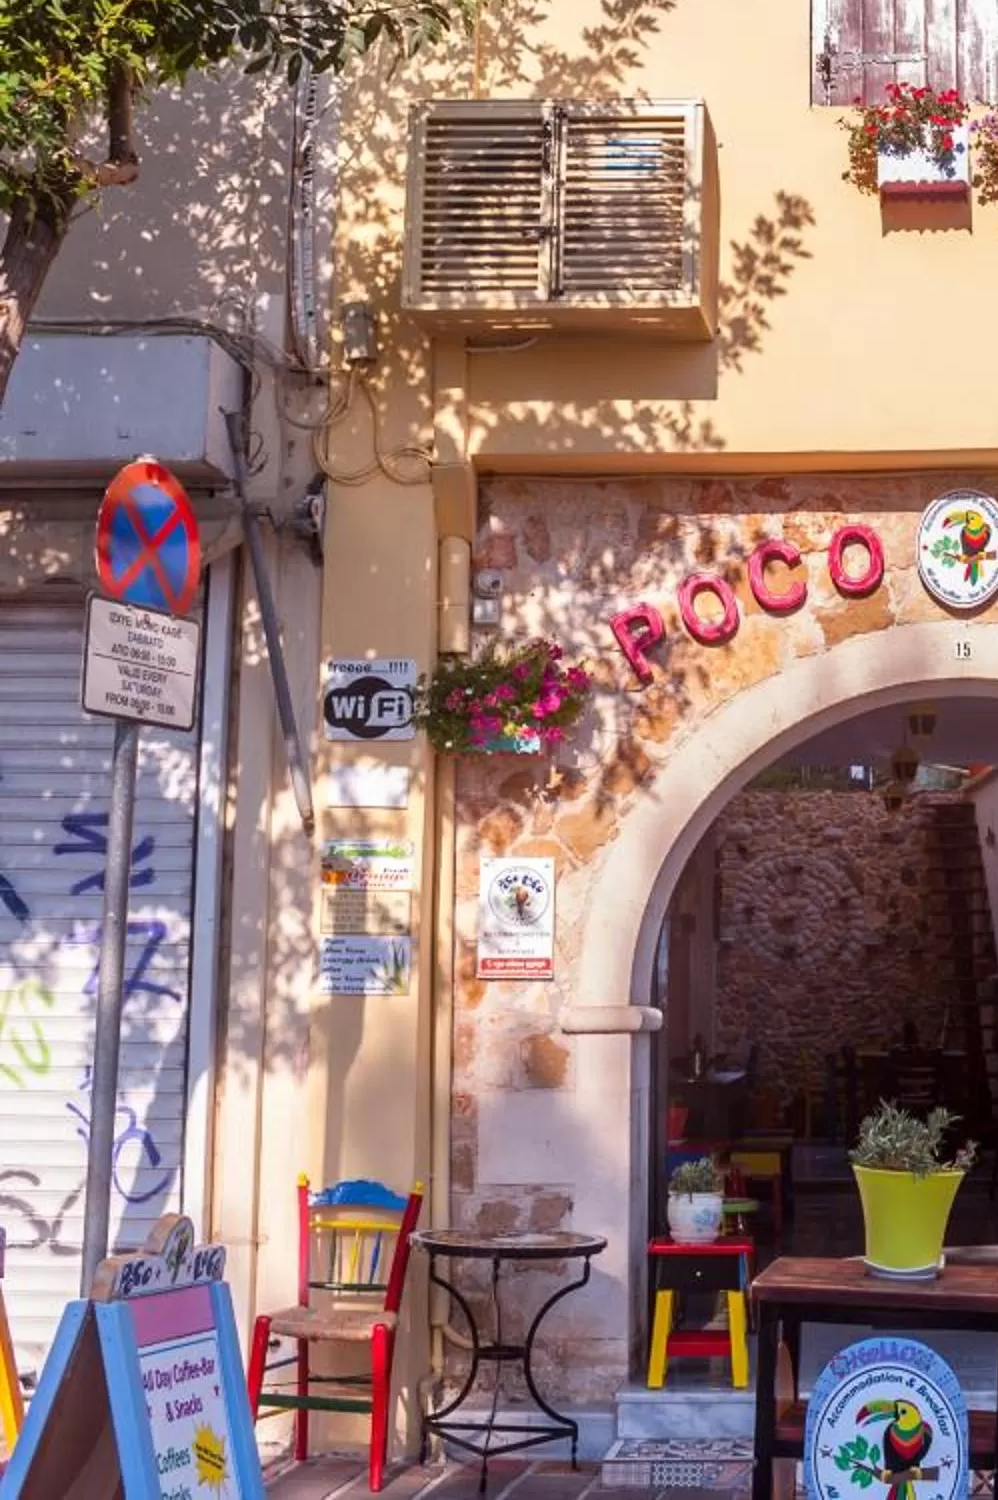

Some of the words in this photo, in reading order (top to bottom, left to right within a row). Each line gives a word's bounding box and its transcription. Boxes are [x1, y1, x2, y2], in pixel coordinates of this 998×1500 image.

[609, 524, 884, 686] POCO
[956, 641, 971, 658] 15
[121, 679, 163, 698] SATURDAY
[142, 670, 167, 683] EVERY
[105, 691, 129, 707] FROM
[155, 1368, 172, 1390] Day
[173, 1357, 215, 1384] Coffee-Bar
[165, 1401, 174, 1422] &
[174, 1396, 203, 1420] Snacks
[827, 1371, 903, 1429] Accommodation
[905, 1377, 917, 1389] &
[157, 1446, 191, 1475] Coffees
